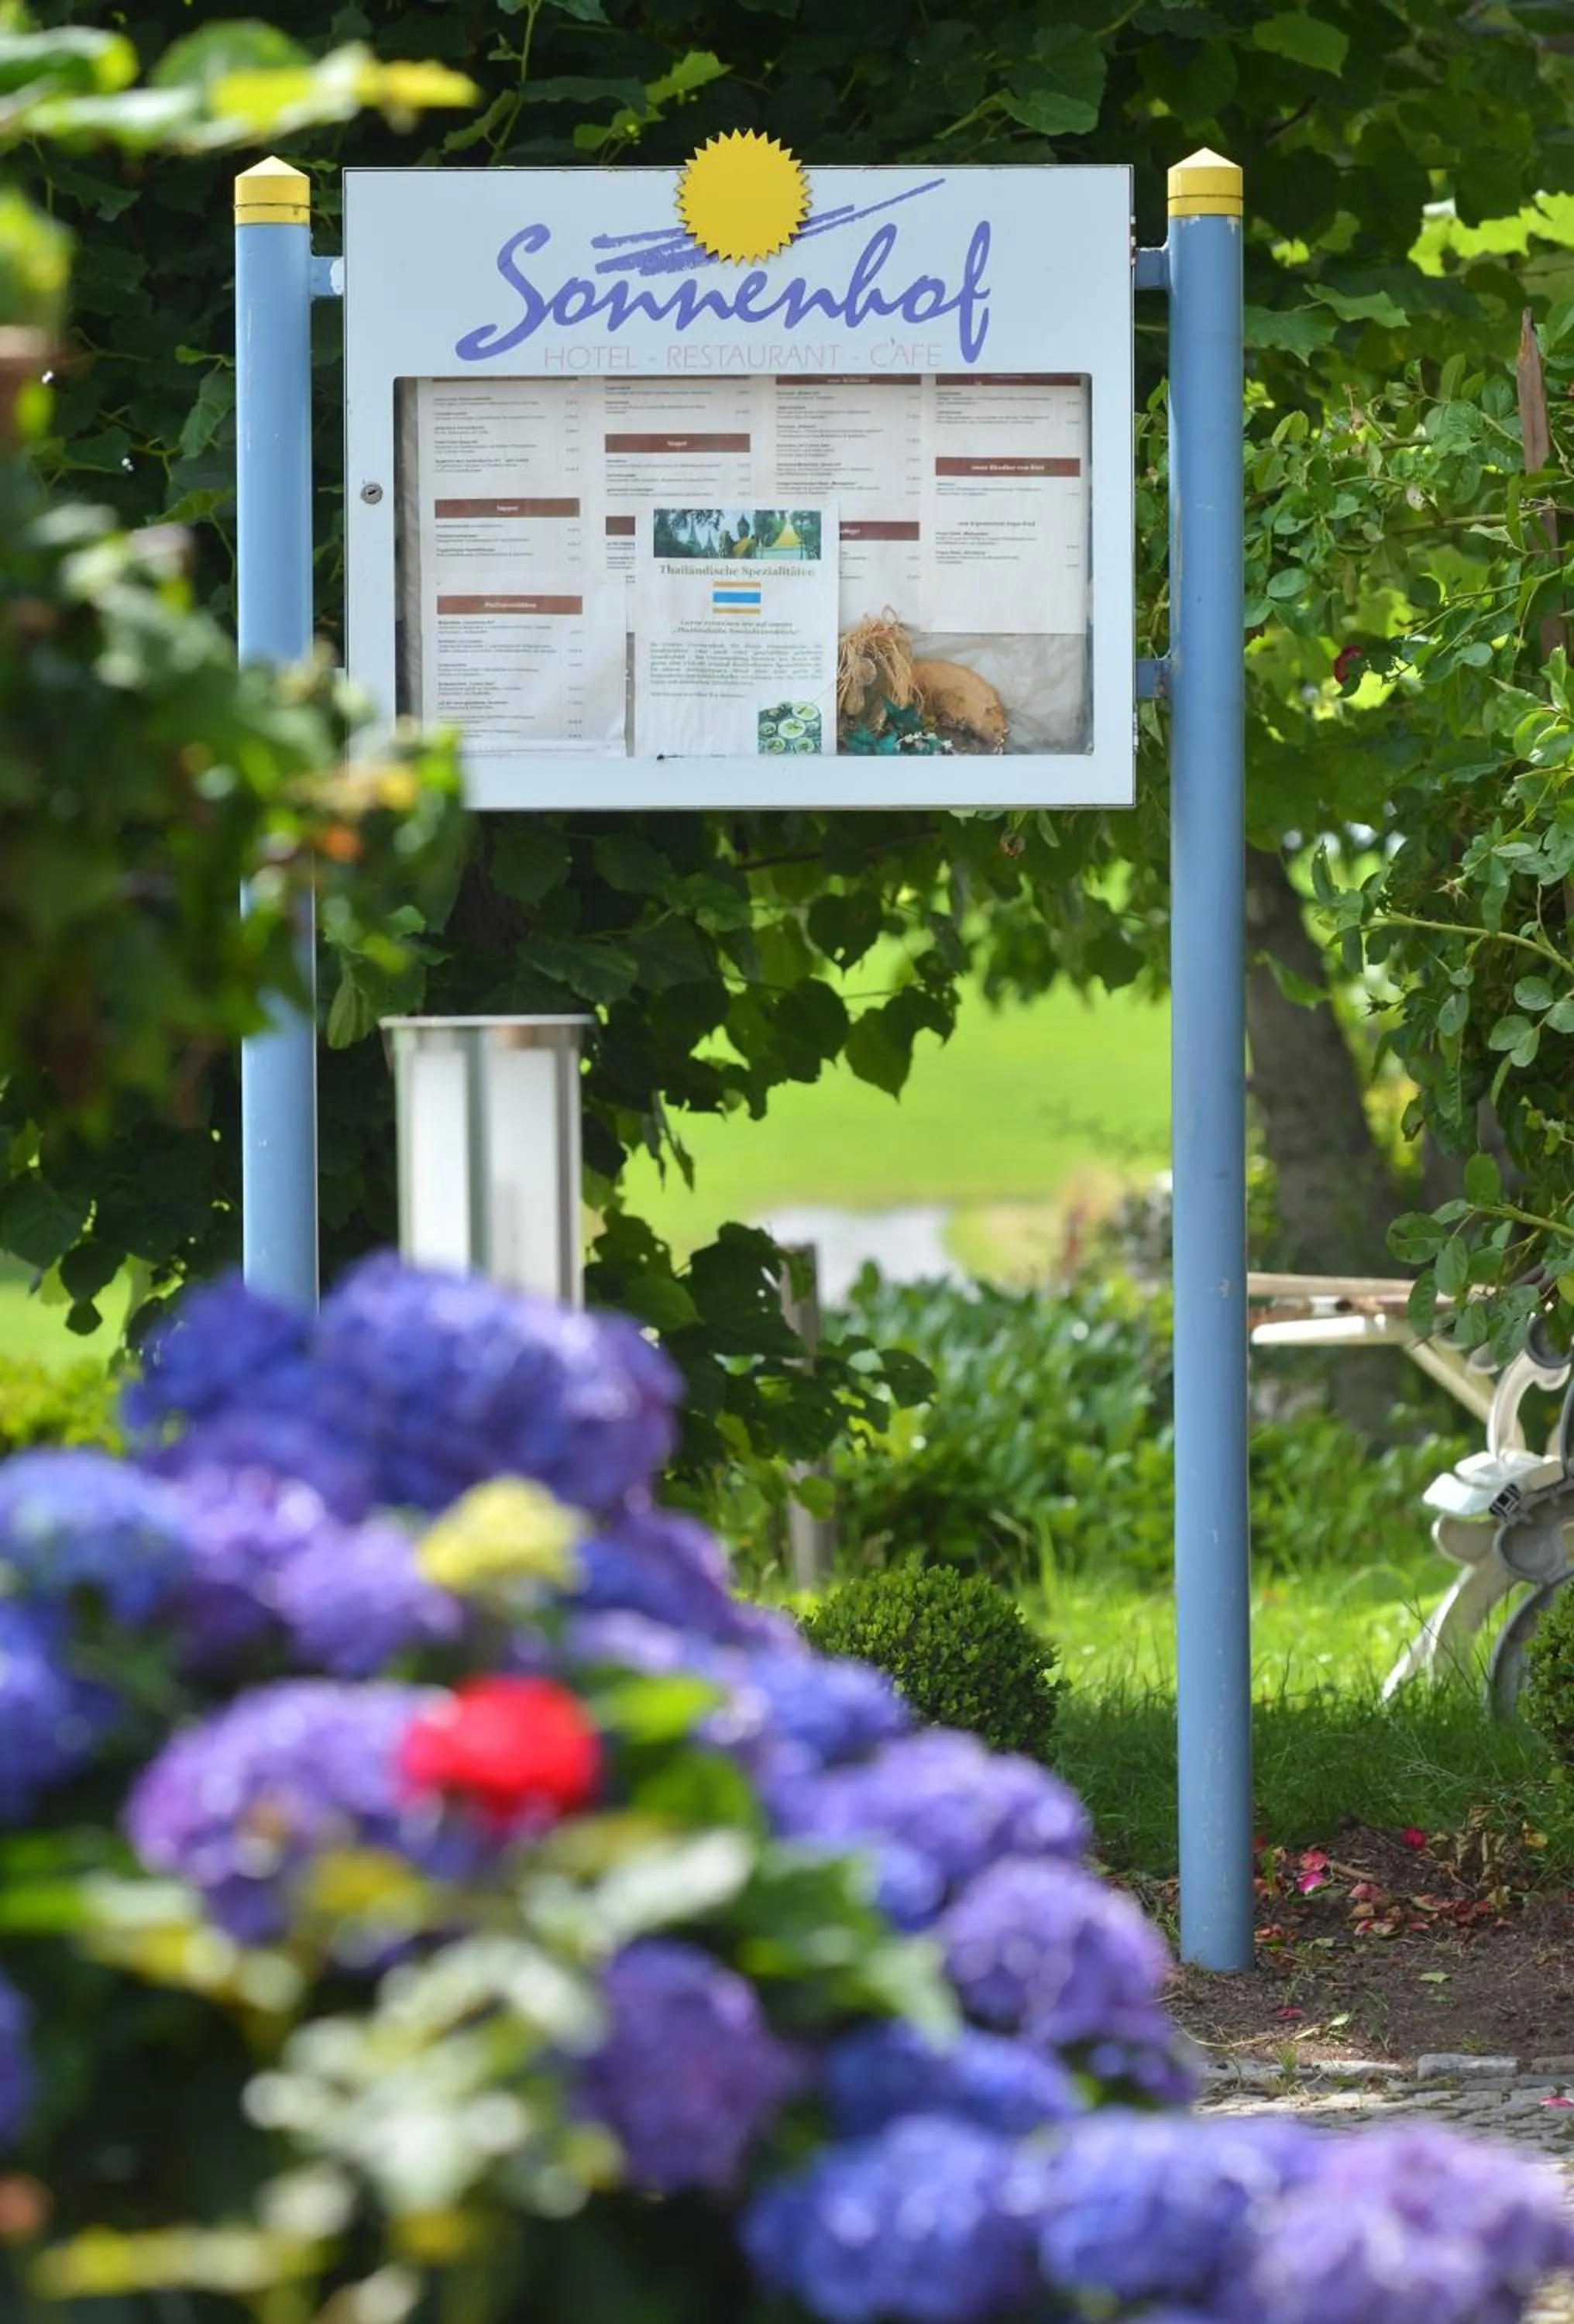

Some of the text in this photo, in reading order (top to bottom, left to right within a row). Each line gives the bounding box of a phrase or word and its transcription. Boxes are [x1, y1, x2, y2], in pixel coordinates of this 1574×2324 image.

[455, 220, 991, 363] Sonnenhof
[545, 346, 638, 370] HOTEL
[666, 343, 842, 370] RESTAURANT
